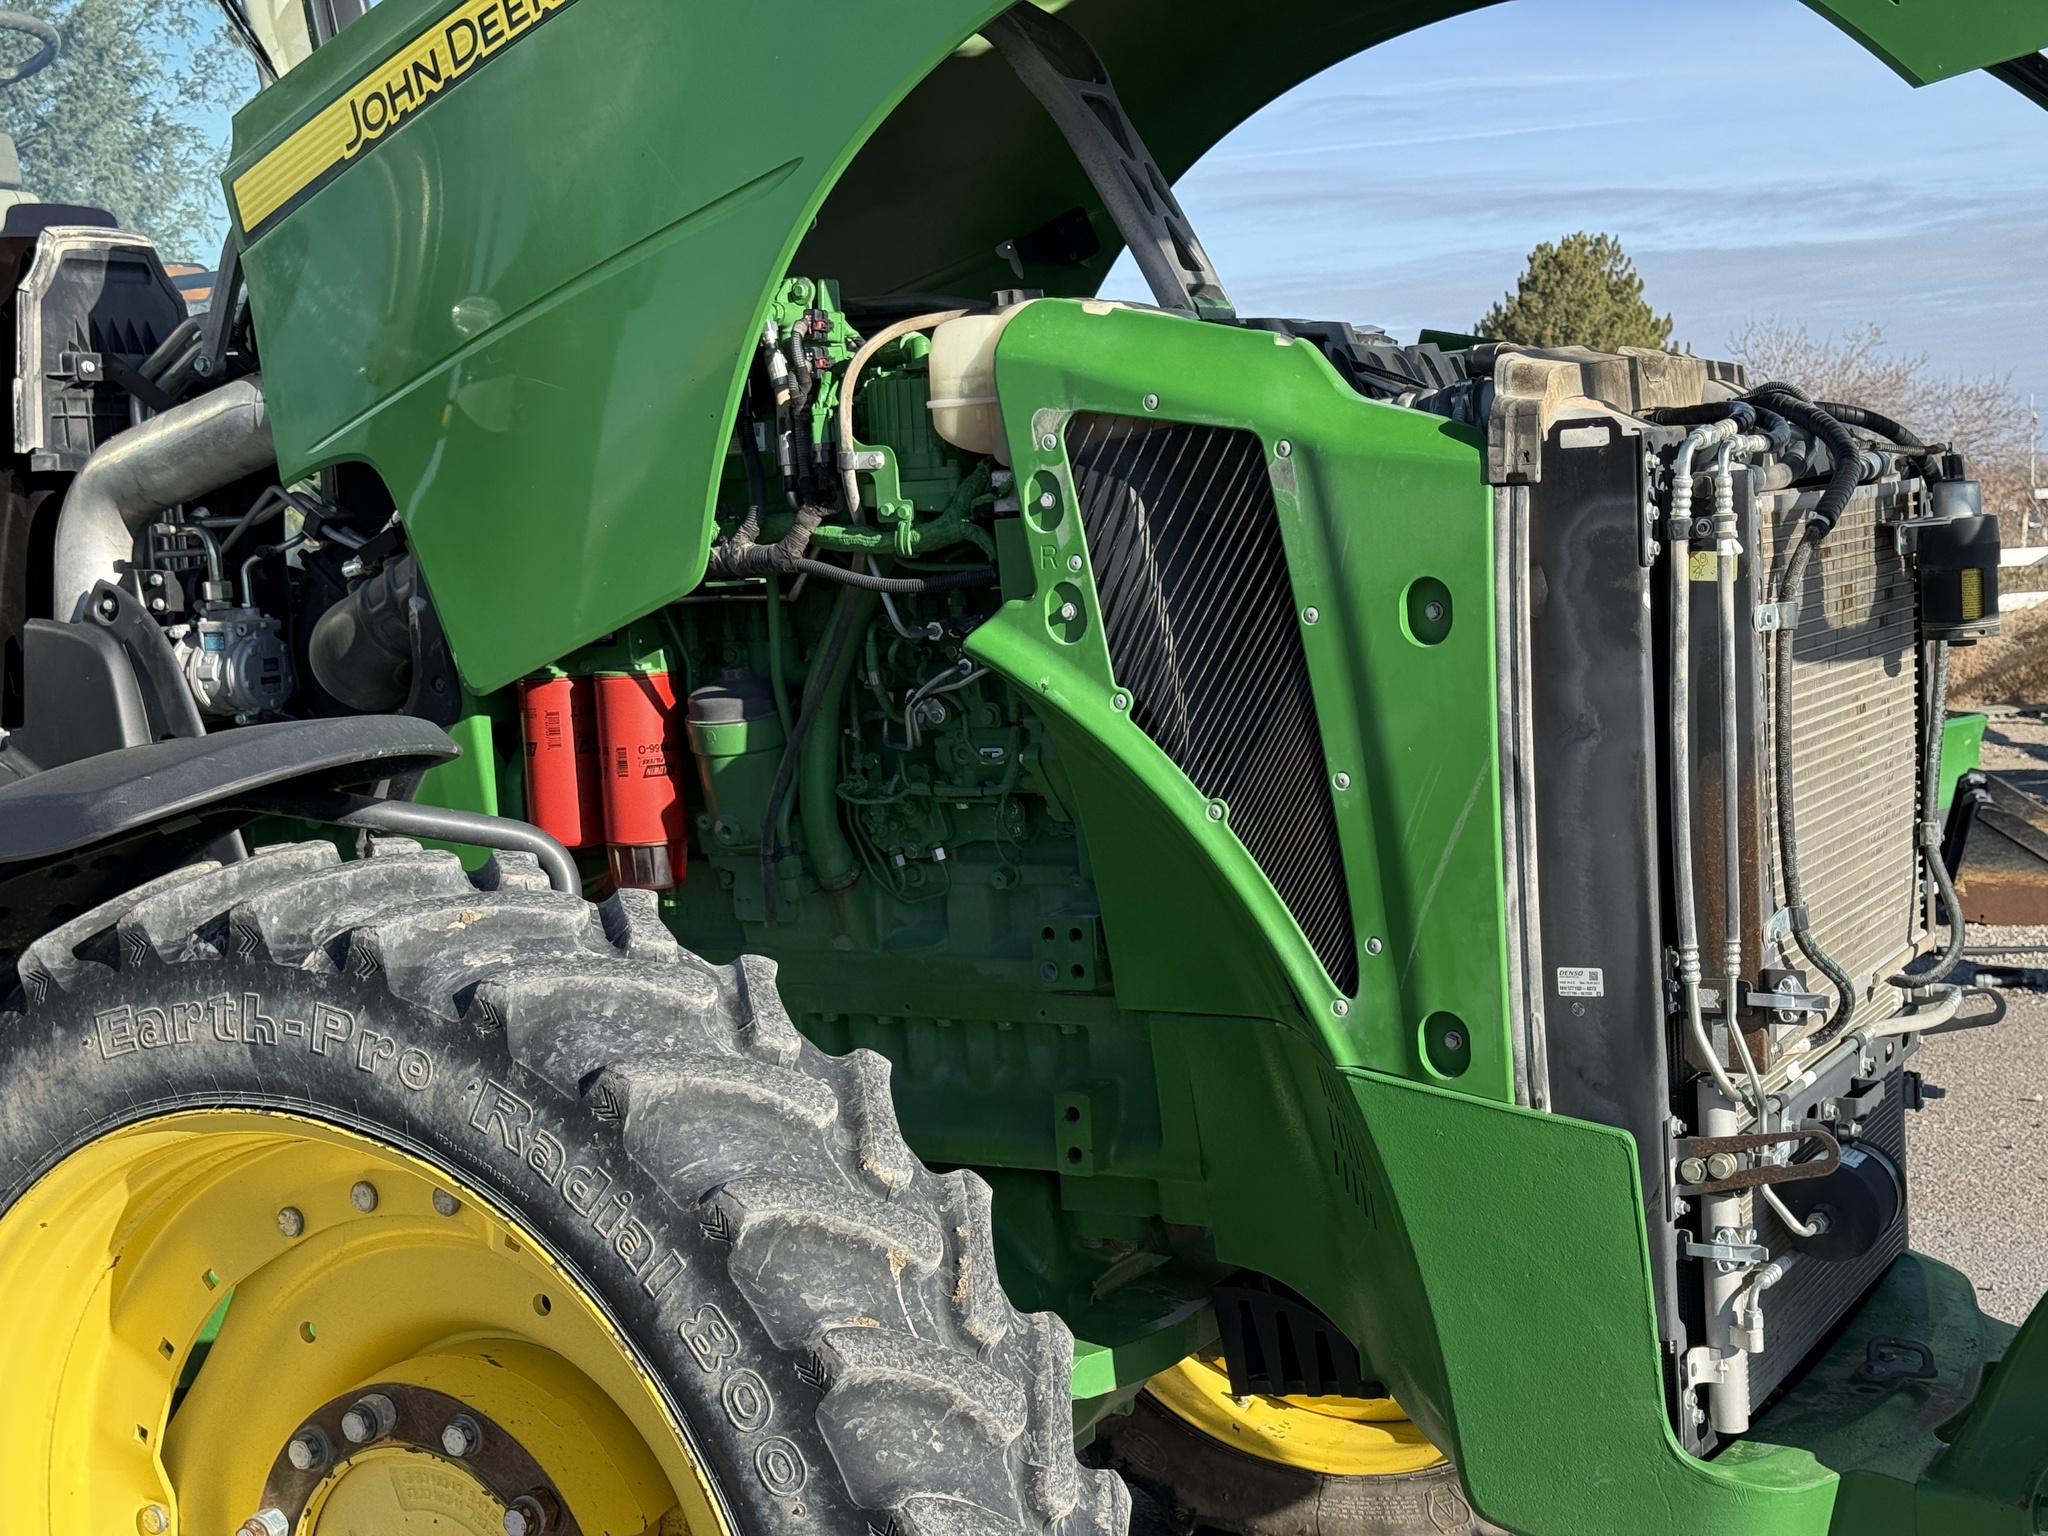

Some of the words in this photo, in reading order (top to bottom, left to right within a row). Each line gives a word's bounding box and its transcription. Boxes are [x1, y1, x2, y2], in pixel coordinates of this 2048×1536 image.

[345, 47, 443, 153] JOHN
[444, 0, 554, 71] DEE
[1040, 544, 1058, 570] R
[94, 992, 434, 1092] Earth-Pro
[468, 1078, 687, 1300] Radial
[678, 1302, 808, 1497] 800
